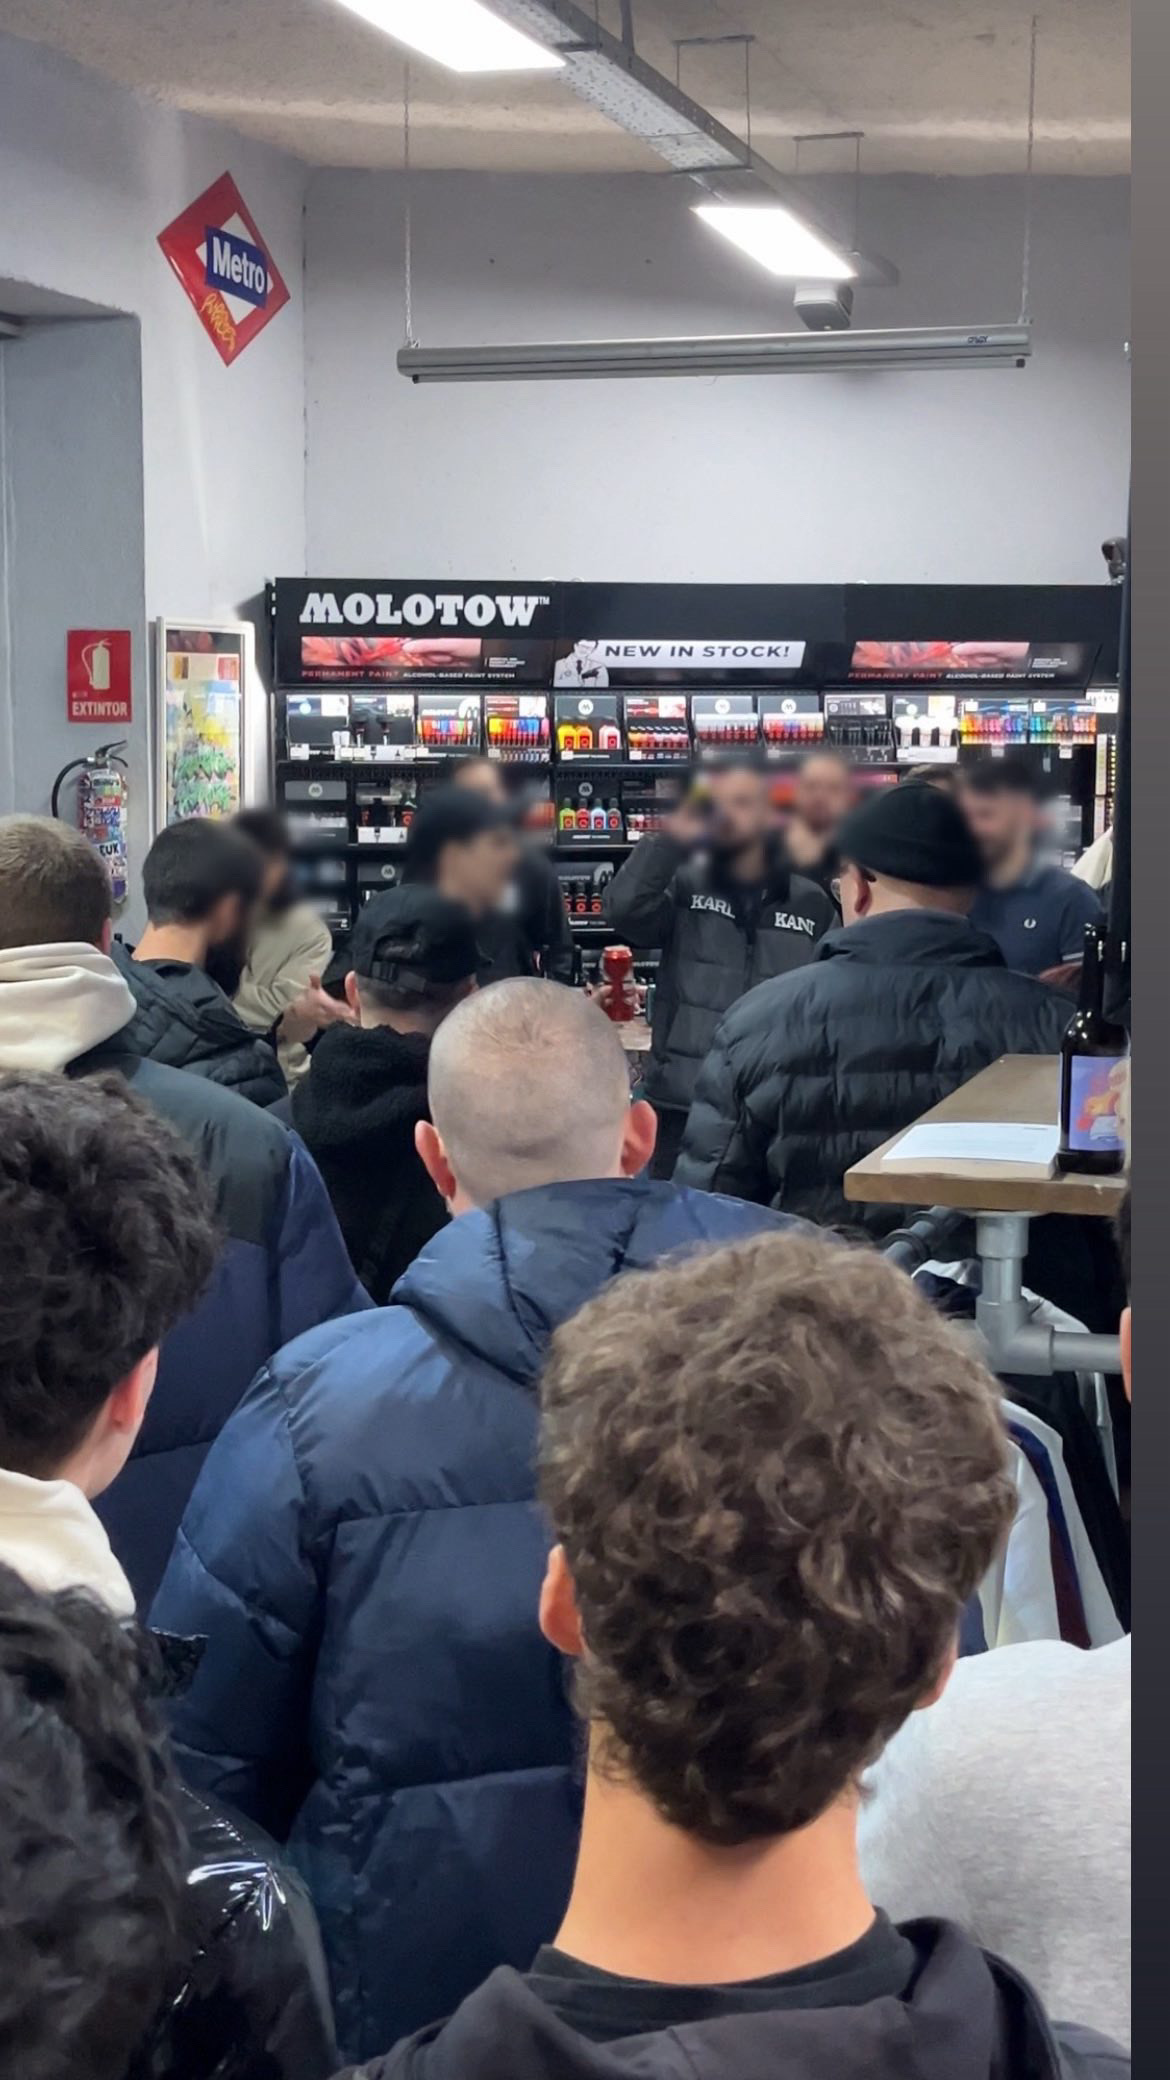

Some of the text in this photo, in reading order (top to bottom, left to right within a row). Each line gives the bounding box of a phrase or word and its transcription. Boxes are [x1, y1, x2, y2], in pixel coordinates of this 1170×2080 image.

[213, 236, 265, 294] Metro
[605, 645, 790, 658] NEW IN STOCK!
[301, 670, 364, 678] PERMANENT
[72, 701, 128, 716] EXTINTOR
[690, 894, 815, 936] KARL KANI
